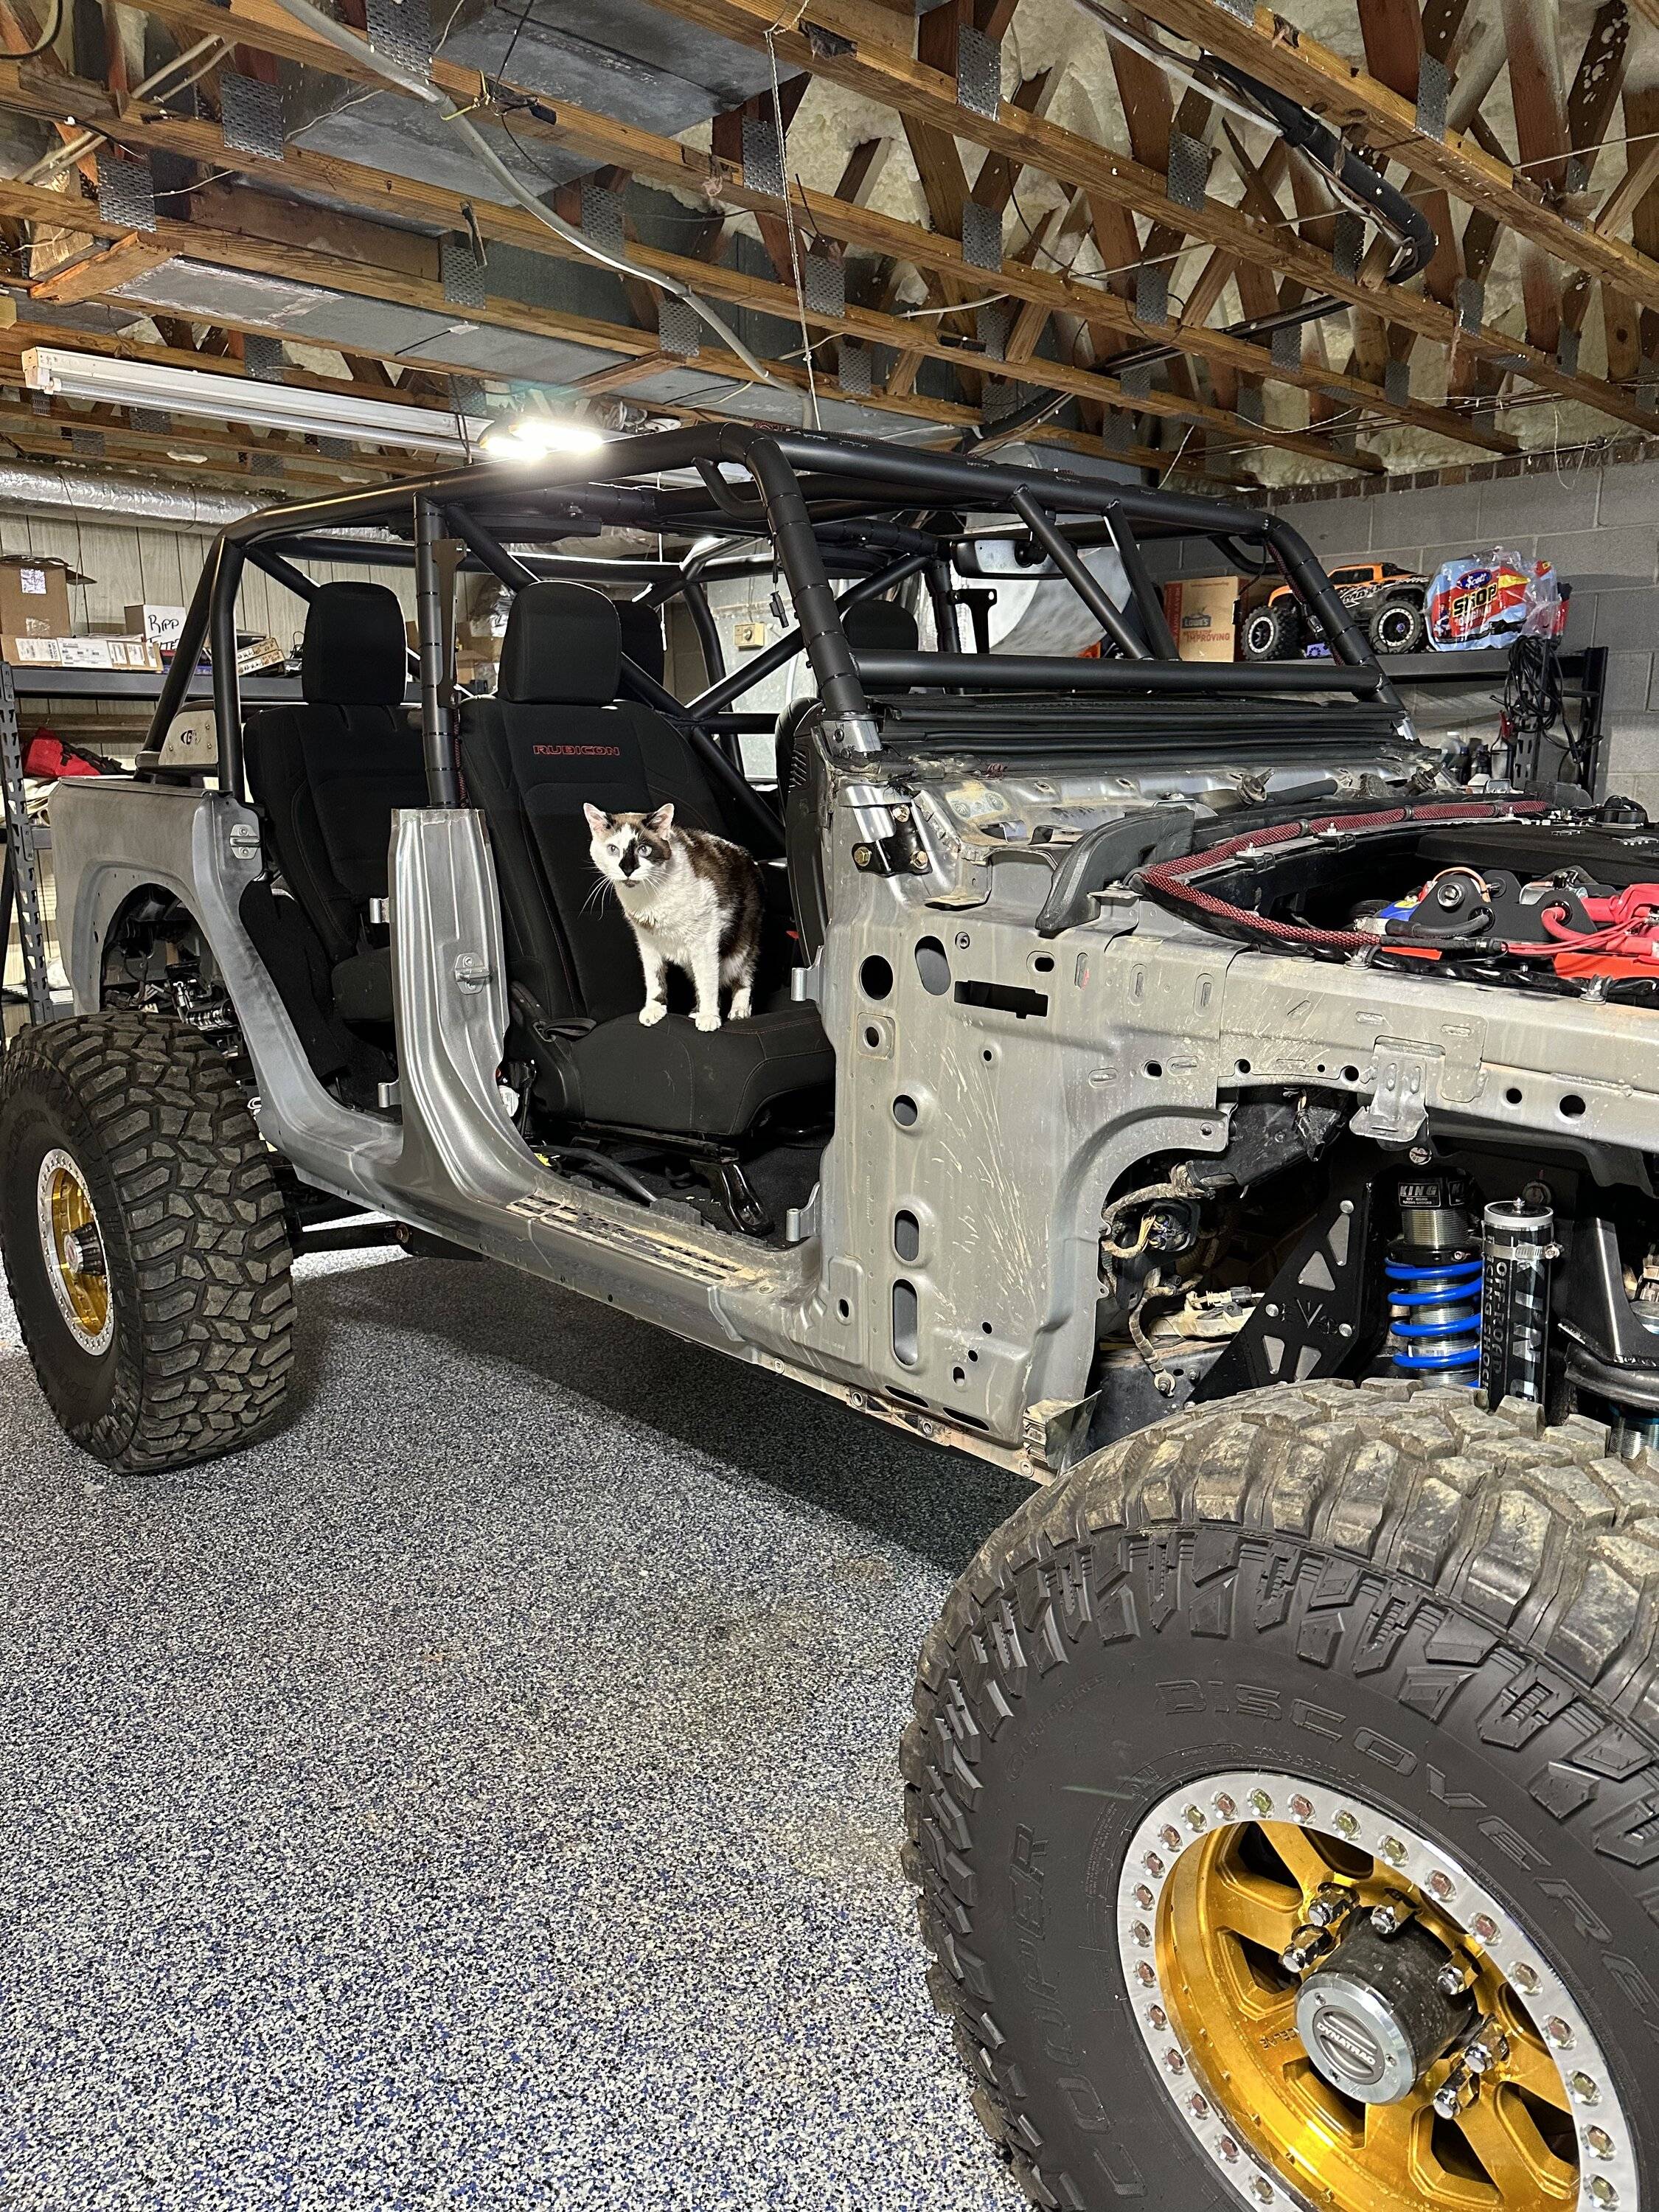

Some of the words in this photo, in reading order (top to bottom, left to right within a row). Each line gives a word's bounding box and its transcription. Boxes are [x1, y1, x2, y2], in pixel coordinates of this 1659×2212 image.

[1453, 583, 1498, 617] SHOP
[533, 745, 620, 757] RUBICON
[1399, 1185, 1437, 1196] KING
[1492, 1261, 1508, 1374] OFF-ROAD
[1155, 1679, 1659, 2046] DISCOVERE
[1259, 2026, 1299, 2051] CELINE
